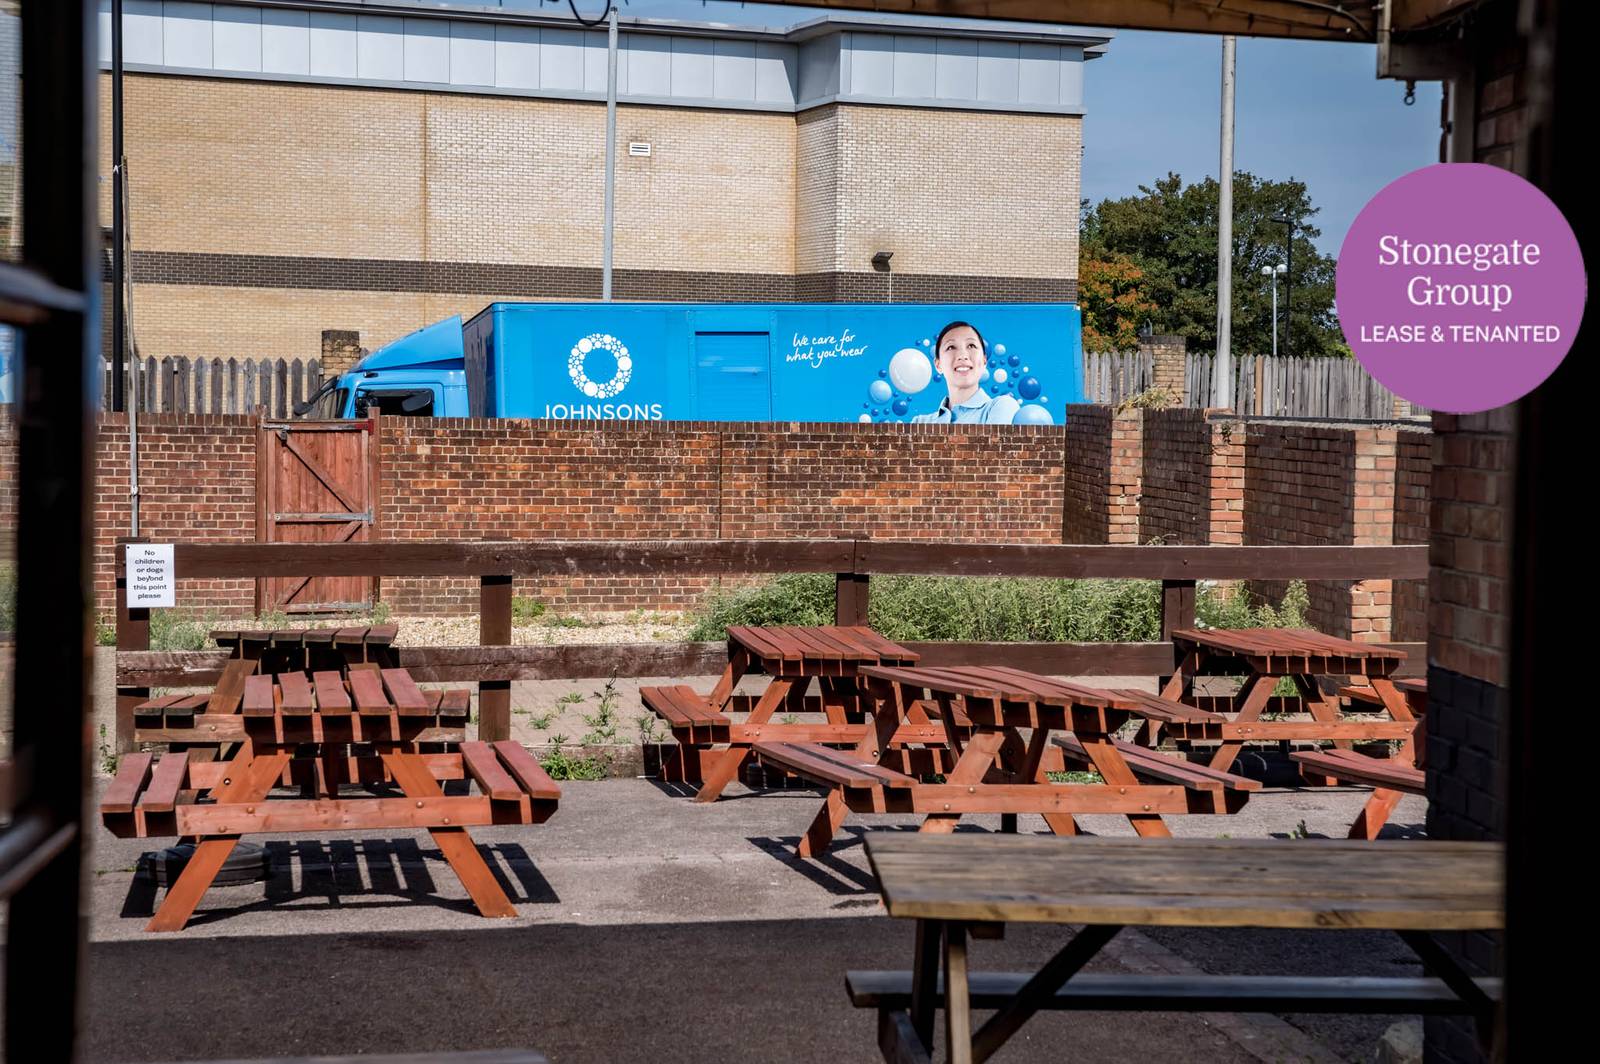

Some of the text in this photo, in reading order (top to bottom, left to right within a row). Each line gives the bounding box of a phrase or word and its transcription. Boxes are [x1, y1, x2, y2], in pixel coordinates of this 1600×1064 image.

[792, 328, 856, 352] We care for
[786, 345, 868, 369] what you wear
[541, 403, 663, 420] JOHNSONS
